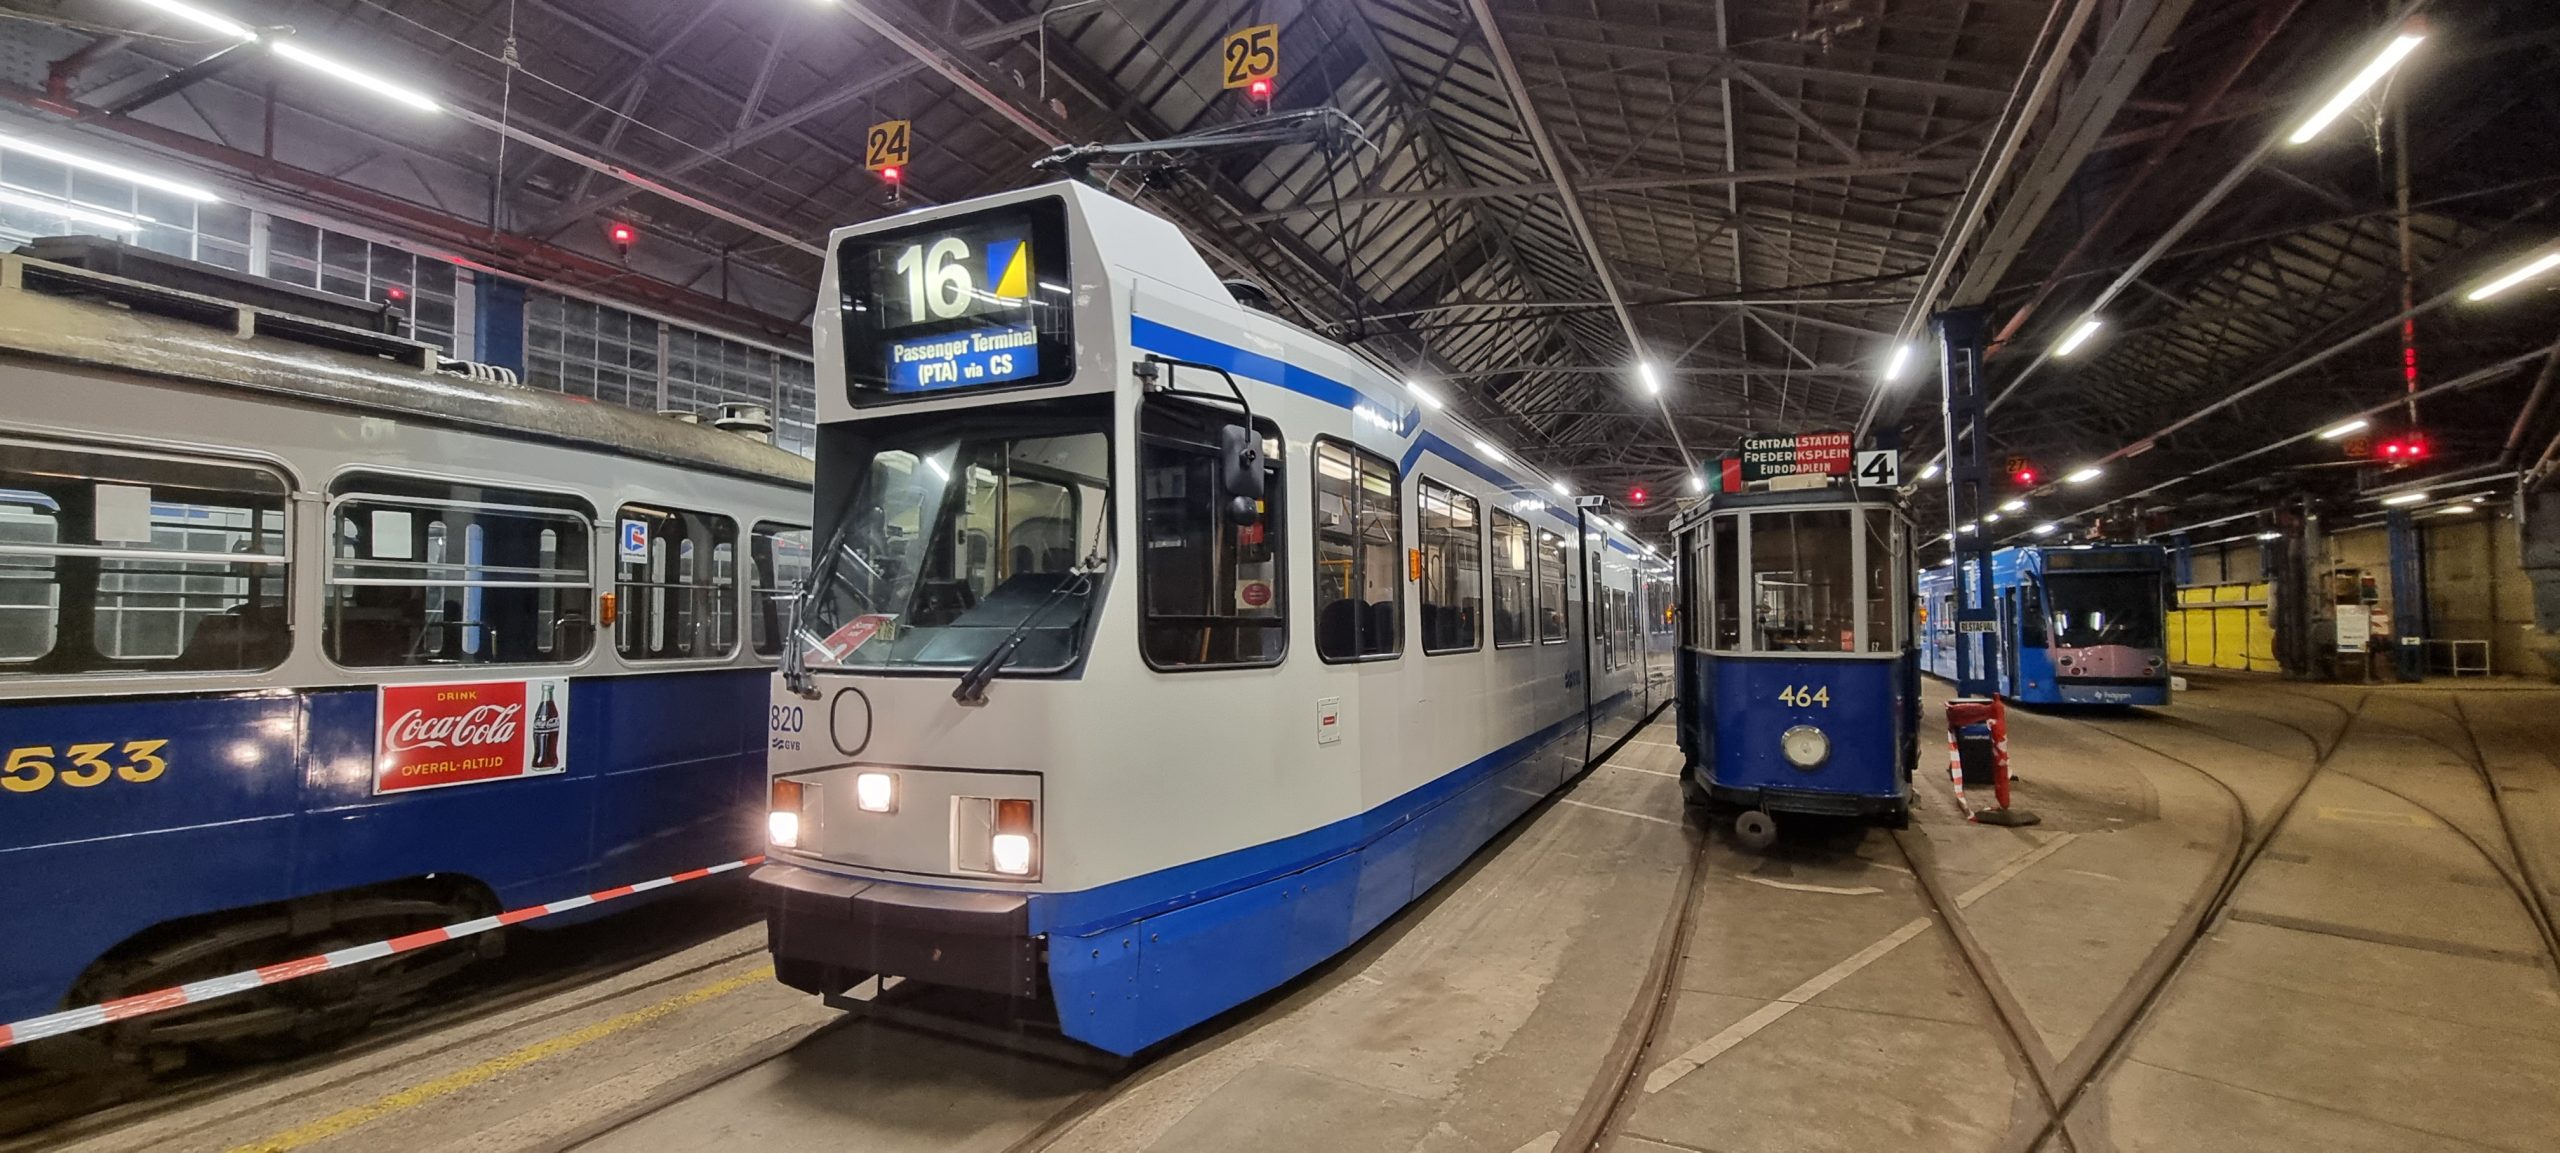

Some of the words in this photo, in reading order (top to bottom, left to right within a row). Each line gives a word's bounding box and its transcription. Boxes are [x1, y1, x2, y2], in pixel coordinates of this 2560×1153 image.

[1226, 29, 1274, 84] 25
[870, 125, 907, 166] 24
[897, 237, 972, 323] 16
[894, 339, 969, 364] Passenger
[971, 325, 1038, 352] Terminal
[918, 360, 958, 386] (PTA)
[964, 363, 983, 379] via
[990, 353, 1013, 376] CS
[1744, 434, 1849, 450] CENTRAALSTATION
[1744, 448, 1850, 463] FREDERIKSPLEIN
[1760, 462, 1831, 475] EUROPAPLEIN
[1861, 453, 1895, 485] 4
[2007, 458, 2025, 472] 27
[437, 691, 478, 702] DRINK
[1778, 684, 1830, 708] 464
[385, 703, 522, 751] Coca-Cola
[771, 705, 803, 733] 820
[785, 740, 801, 751] GVB
[0, 739, 169, 793] 533
[402, 756, 504, 777] OVERAL-ALTIJD
